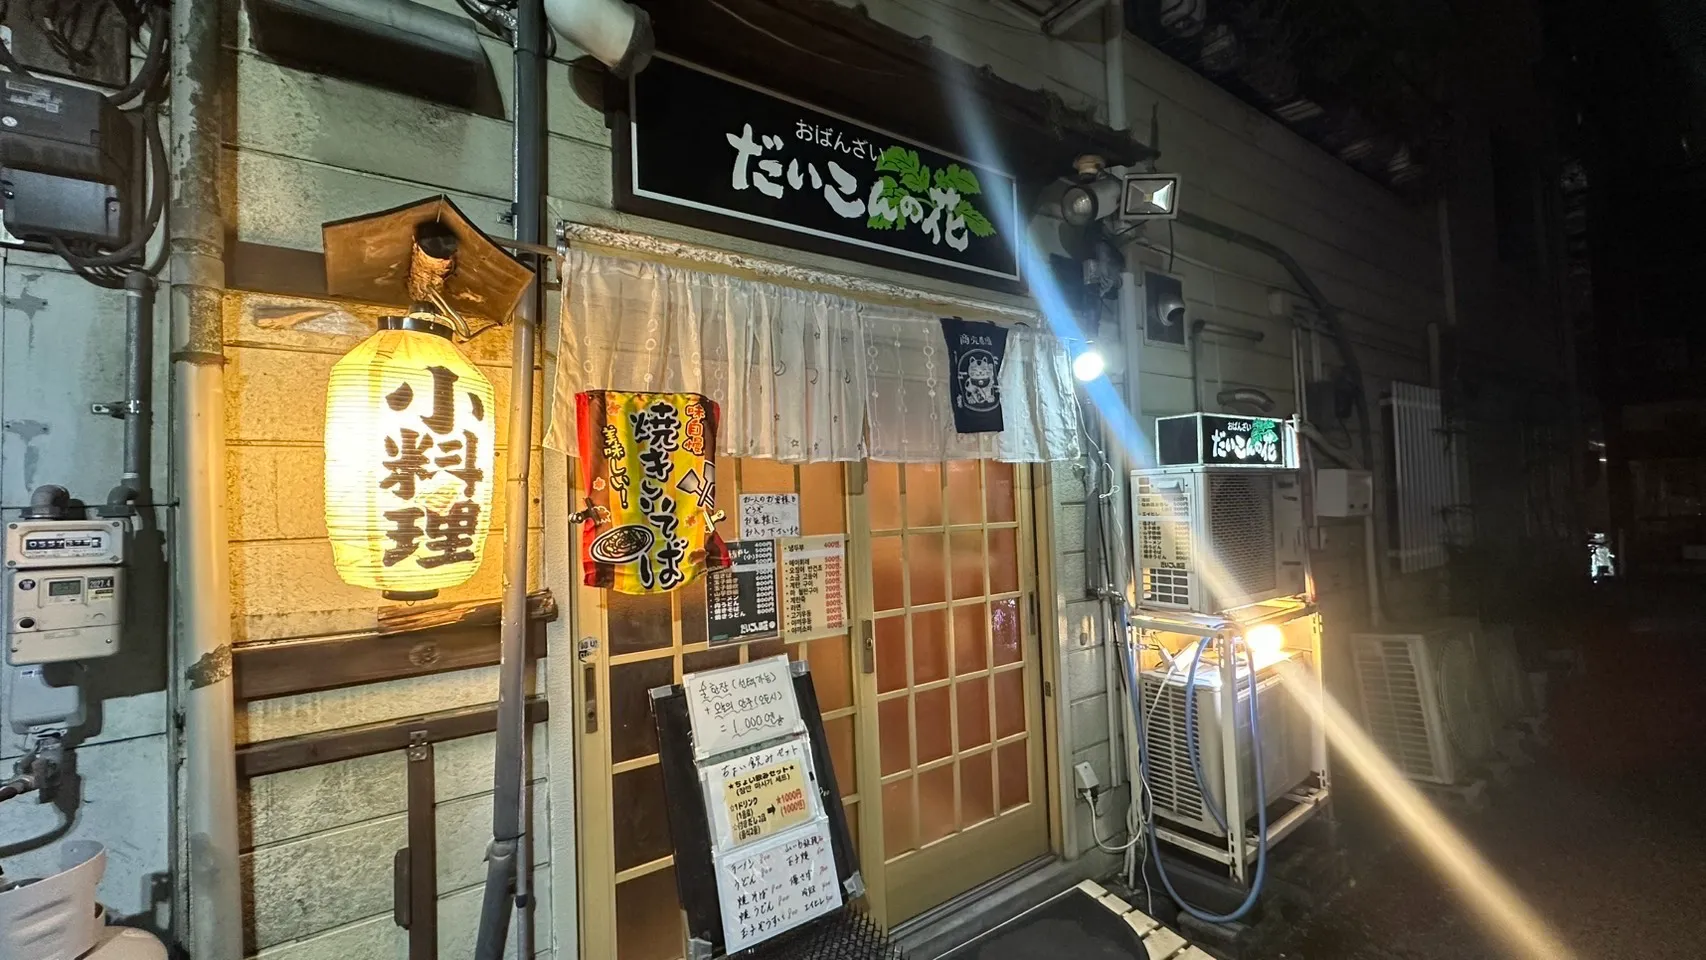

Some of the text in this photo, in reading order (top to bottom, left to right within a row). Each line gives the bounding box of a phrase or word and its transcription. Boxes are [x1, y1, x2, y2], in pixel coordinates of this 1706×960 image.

[795, 118, 884, 162] おばんざい
[725, 122, 969, 252] だいこんの花
[682, 402, 706, 456] 味自慢
[1227, 421, 1252, 432] おばんざい
[1211, 428, 1278, 462] だいこんの花
[379, 365, 485, 569] 小料理
[629, 401, 689, 589] 焼きそば
[744, 505, 764, 514] どうぞ
[802, 580, 814, 588] 구이
[776, 773, 791, 783] 세트)
[734, 876, 757, 890] うどん
[804, 898, 825, 912] エイヒレ
